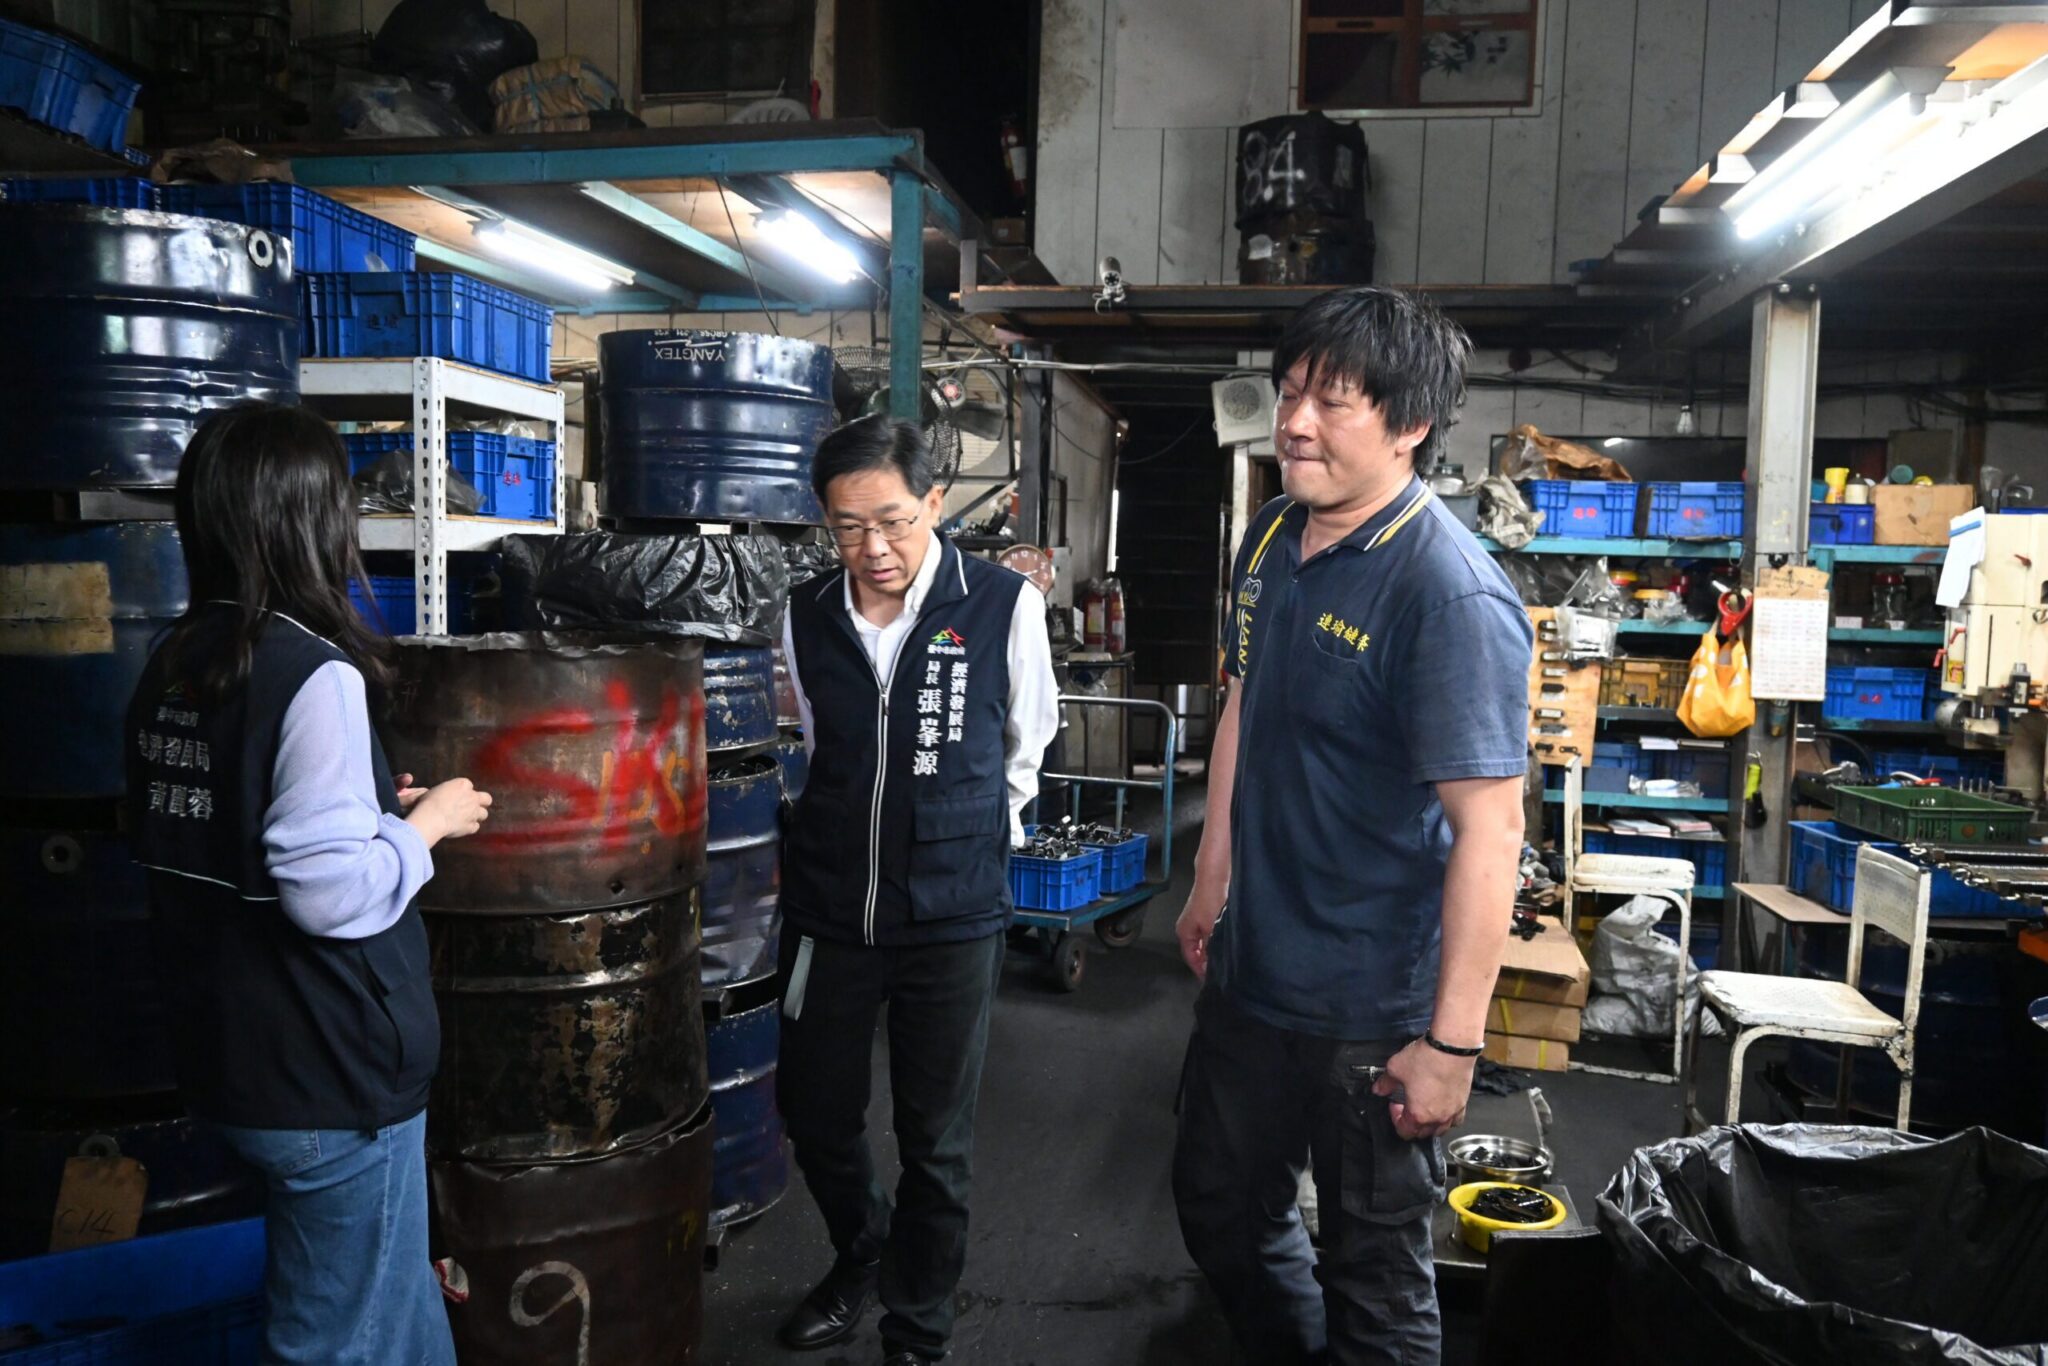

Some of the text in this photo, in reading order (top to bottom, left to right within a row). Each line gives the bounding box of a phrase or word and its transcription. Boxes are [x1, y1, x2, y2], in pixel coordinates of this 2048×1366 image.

[654, 347, 726, 362] YANGTEX
[911, 659, 943, 776] 局長 張峯源
[946, 661, 970, 743] 經濟發展局
